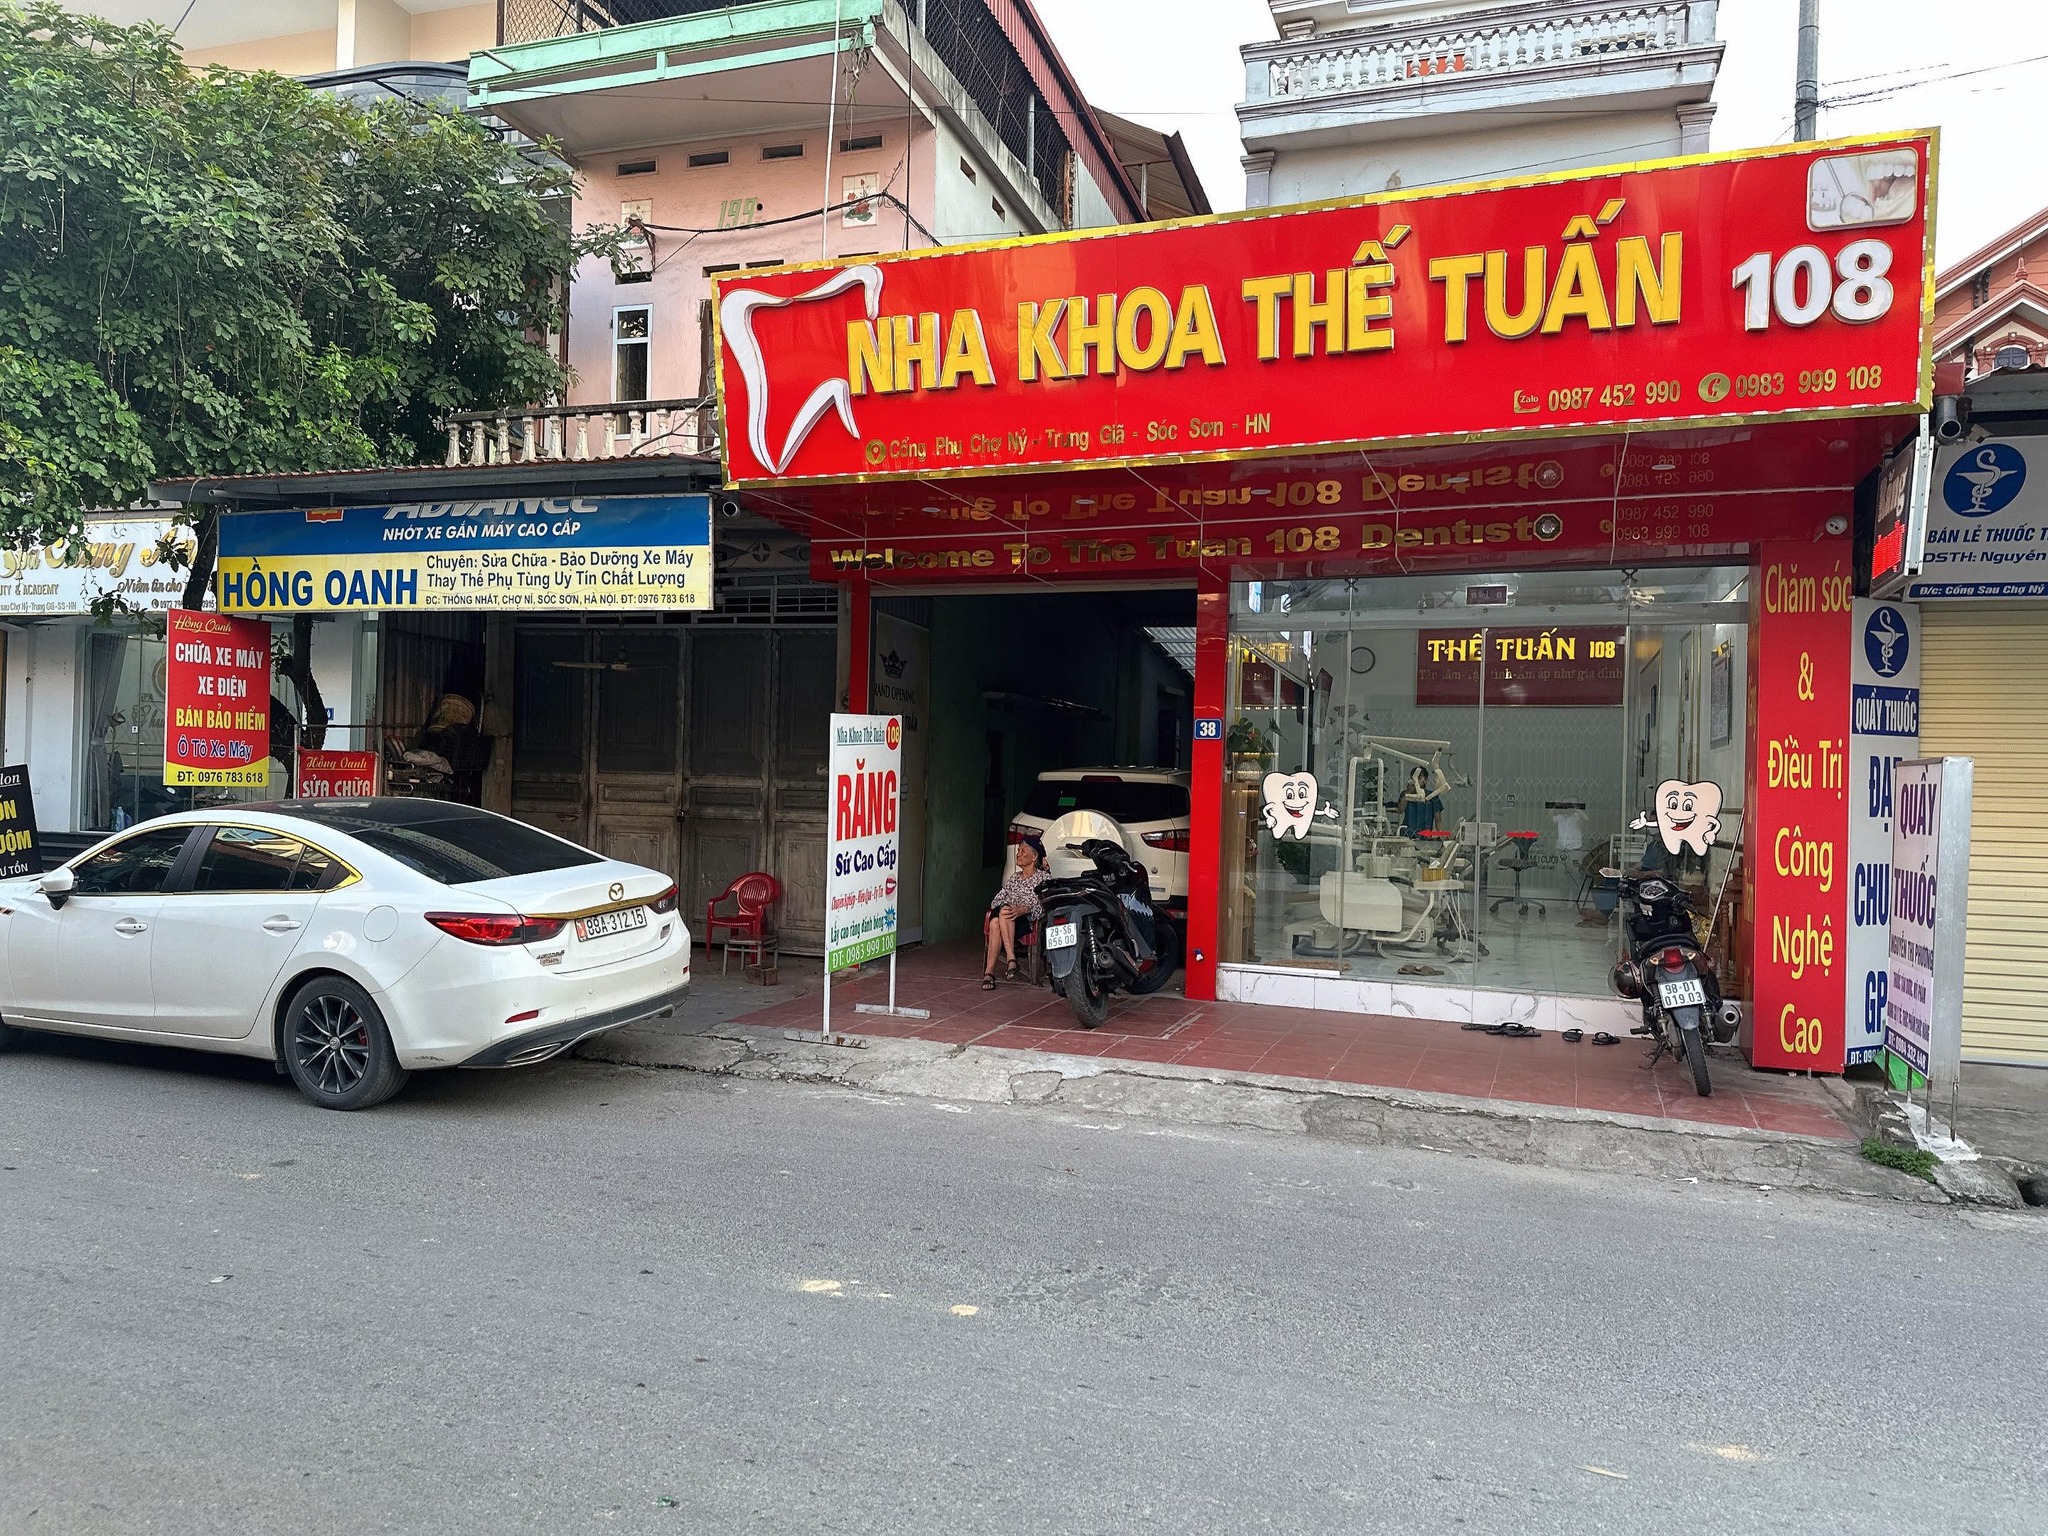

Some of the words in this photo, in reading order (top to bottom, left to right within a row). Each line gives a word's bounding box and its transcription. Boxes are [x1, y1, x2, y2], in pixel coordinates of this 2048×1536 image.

[848, 308, 996, 396] NHA
[1018, 284, 1225, 382] KHOA
[1243, 224, 1412, 362] THẾ
[1430, 198, 1683, 343] TUẤN
[1733, 239, 1894, 332] 108
[1548, 388, 1594, 411] 0987
[1600, 384, 1635, 407] 452
[1646, 380, 1681, 404] 990
[1736, 374, 1784, 398] 0983
[1798, 368, 1837, 393] 999
[1846, 365, 1882, 390] 108
[936, 436, 963, 459] Phụ
[970, 432, 1001, 457] Chợ
[1046, 428, 1090, 451] Trung
[1100, 423, 1125, 446] Giã
[1146, 418, 1177, 441] Sóc
[1188, 417, 1223, 438] Sơn
[1245, 412, 1271, 435] HN
[1617, 507, 1650, 521] 0987
[1653, 505, 1680, 519] 452
[1688, 503, 1714, 518] 990
[383, 524, 424, 541] NHỚT
[425, 526, 443, 540] XE
[446, 521, 478, 539] GẮN
[481, 520, 515, 537] MÁY
[517, 523, 548, 537] CAO
[552, 517, 581, 536] CẤP
[830, 548, 995, 571] Welcome
[1004, 542, 1051, 566] To
[1062, 540, 1137, 564] The
[1147, 535, 1252, 559] Tuan
[1266, 526, 1342, 554] 108
[1362, 515, 1536, 550] Dentist
[1616, 526, 1649, 540] 0983
[1656, 525, 1681, 539] 999
[1687, 523, 1710, 538] 108
[1928, 527, 1960, 544] BÁN
[1963, 524, 1982, 542] LẺ
[1986, 523, 2036, 542] THUỐC
[426, 554, 478, 572] Chuyên:
[481, 553, 508, 568] Sửa
[511, 553, 548, 568] Chữa
[560, 551, 586, 566] Bảo
[590, 551, 639, 568] Dưỡng
[642, 550, 661, 565] Xe
[665, 549, 694, 568] Máy
[1923, 551, 1976, 563] DSTH:
[1980, 548, 2047, 565] Nguyễn
[23, 583, 59, 596] ACADEMY
[223, 557, 313, 608] HỒNG
[324, 568, 418, 606] OANH
[427, 573, 457, 591] Thay
[460, 569, 484, 587] Thế
[488, 572, 513, 590] Phụ
[517, 571, 550, 589] Tùng
[576, 569, 597, 585] Tín
[601, 566, 634, 586] Chất
[638, 570, 686, 588] Lượng
[1765, 563, 1816, 614] Chăm
[1821, 560, 1851, 613] sóc
[1977, 585, 2000, 595] Sau
[2002, 584, 2026, 596] Chợ
[426, 595, 441, 605] ĐC:
[502, 594, 522, 607] CHỢ
[537, 592, 557, 604] SÓC
[584, 592, 598, 604] HÀ
[620, 595, 637, 604] ĐT:
[638, 594, 659, 604] 0976
[661, 594, 677, 604] 783
[679, 593, 695, 603] 618
[173, 614, 204, 633] Hồng
[204, 618, 233, 632] Oanh
[175, 640, 211, 664] CHỮA
[215, 646, 232, 667] XE
[236, 646, 264, 669] MÁY
[1496, 627, 1576, 662] TUẤN
[1589, 640, 1616, 660] 108
[197, 675, 214, 696] XE
[218, 675, 247, 701] ĐIỆN
[1797, 651, 1816, 701] &
[175, 705, 203, 728] BÁN
[206, 703, 232, 730] BẢO
[235, 705, 266, 731] HIỂM
[1855, 687, 1883, 734] QUẦY
[1884, 690, 1917, 734] THUỐC
[887, 726, 900, 744] 108
[1199, 721, 1216, 737] 38
[178, 734, 189, 758] Ô
[191, 738, 207, 758] Tô
[209, 739, 226, 758] Xe
[229, 738, 253, 762] Máy
[306, 755, 337, 770] Hồng
[340, 755, 368, 770] Oanh
[1767, 735, 1812, 790] Điều
[1819, 738, 1843, 801] Trị
[177, 771, 195, 783] ĐT:
[198, 771, 223, 783] 0976
[225, 771, 243, 783] 783
[246, 771, 263, 783] 618
[302, 774, 333, 797] SỬA
[334, 772, 371, 797] CHỮA
[836, 757, 898, 842] RĂNG
[1900, 764, 1937, 836] QUẦY
[835, 851, 853, 877] Sứ
[853, 849, 874, 873] Cao
[877, 839, 897, 871] Cấp
[1774, 825, 1834, 893] Công
[1893, 854, 1936, 930] THUỐC
[1050, 925, 1072, 938] 29-S6
[832, 950, 845, 969] ĐT:
[846, 943, 865, 964] 0983
[866, 938, 880, 957] 999
[881, 934, 894, 952] 108
[1772, 914, 1834, 980] Nghệ
[1664, 991, 1703, 1006] 019.03
[1665, 980, 1696, 995] 98-D1
[1779, 1003, 1823, 1055] Cao
[1850, 1050, 1862, 1065] ĐT:
